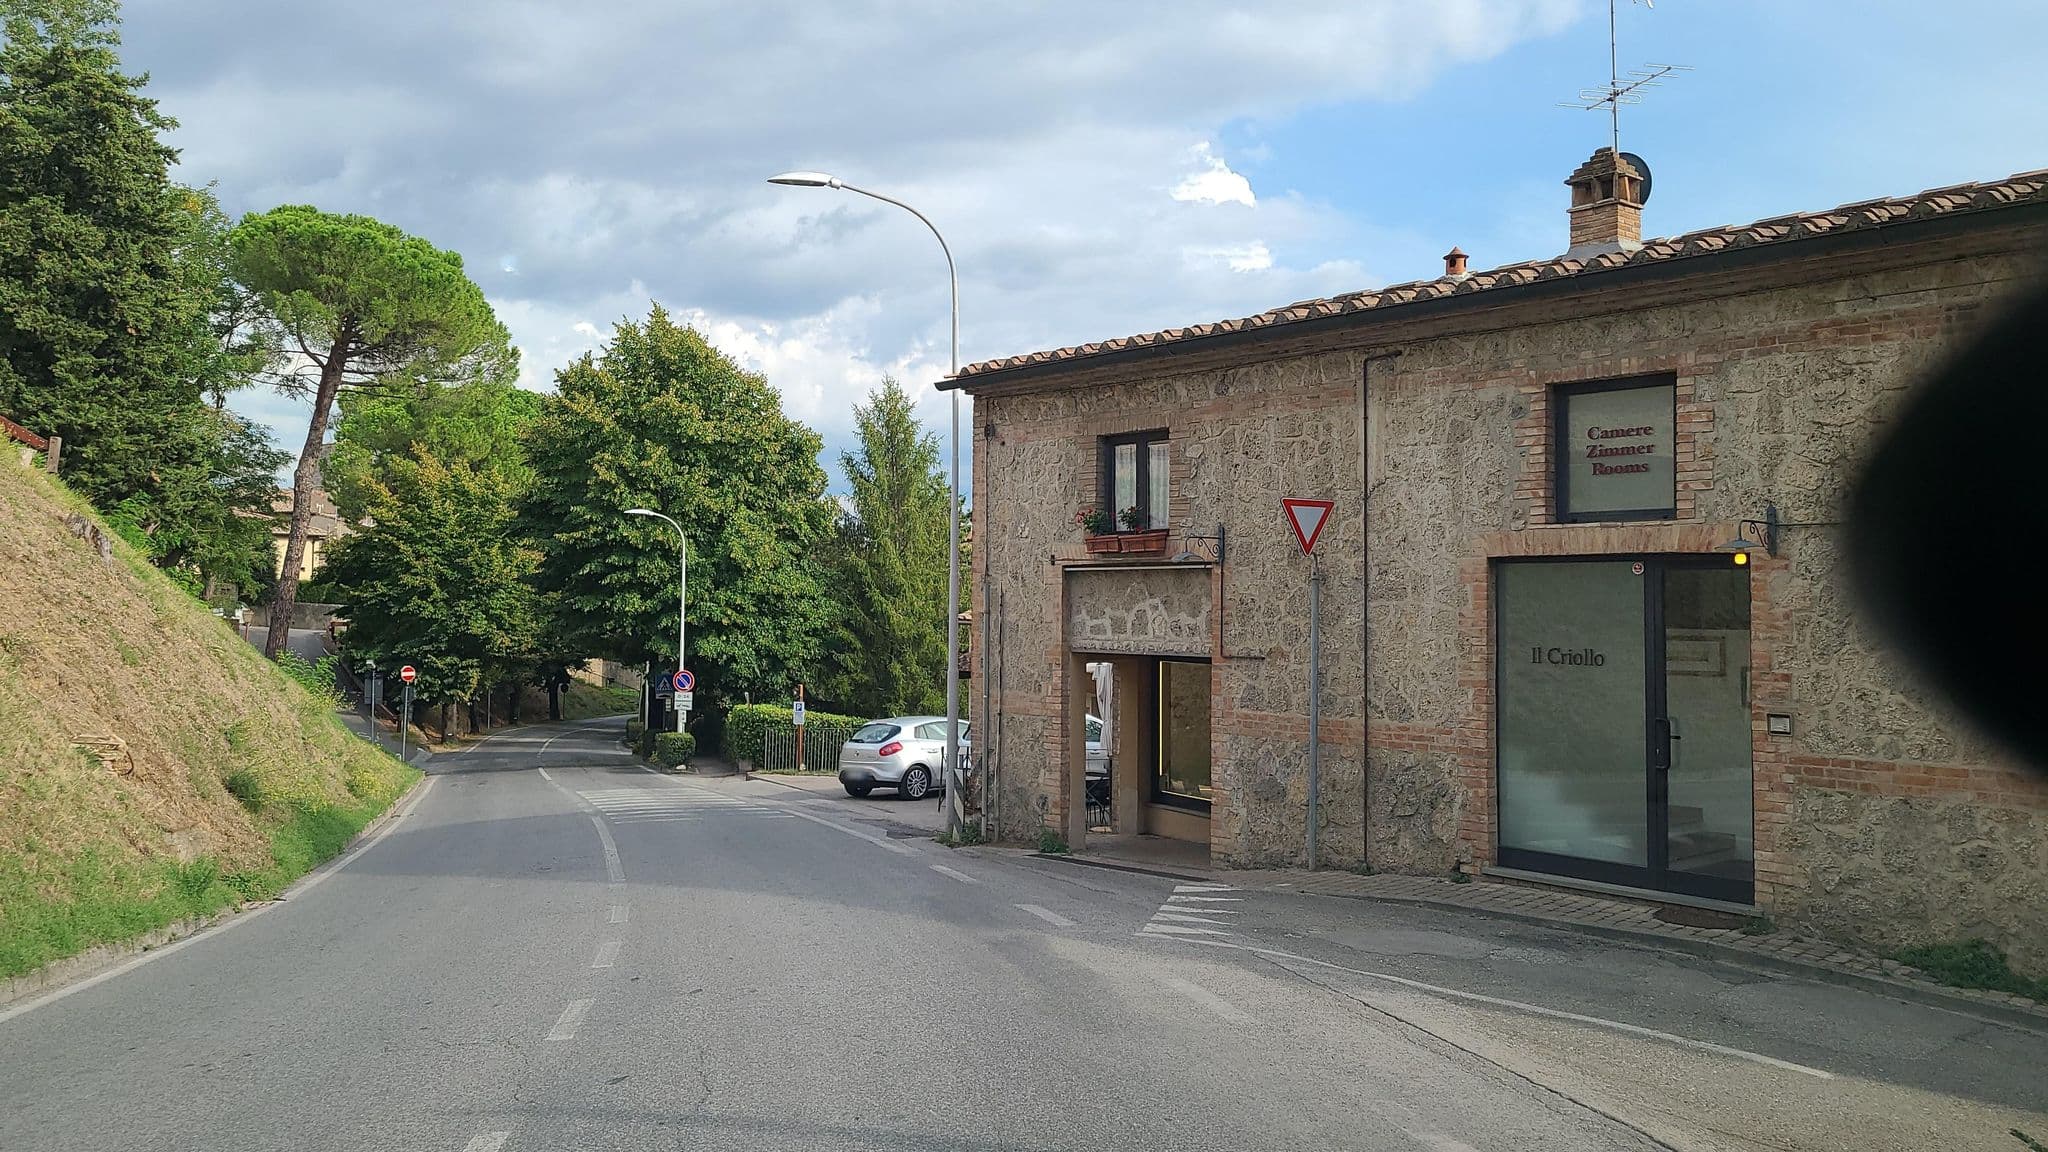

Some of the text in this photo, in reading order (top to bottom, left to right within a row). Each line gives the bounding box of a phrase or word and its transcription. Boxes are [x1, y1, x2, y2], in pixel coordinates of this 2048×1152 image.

[1587, 426, 1654, 440] Camere
[1586, 444, 1655, 458] Zimmer
[1592, 462, 1649, 476] Rooms
[1531, 647, 1605, 667] Il Criollo
